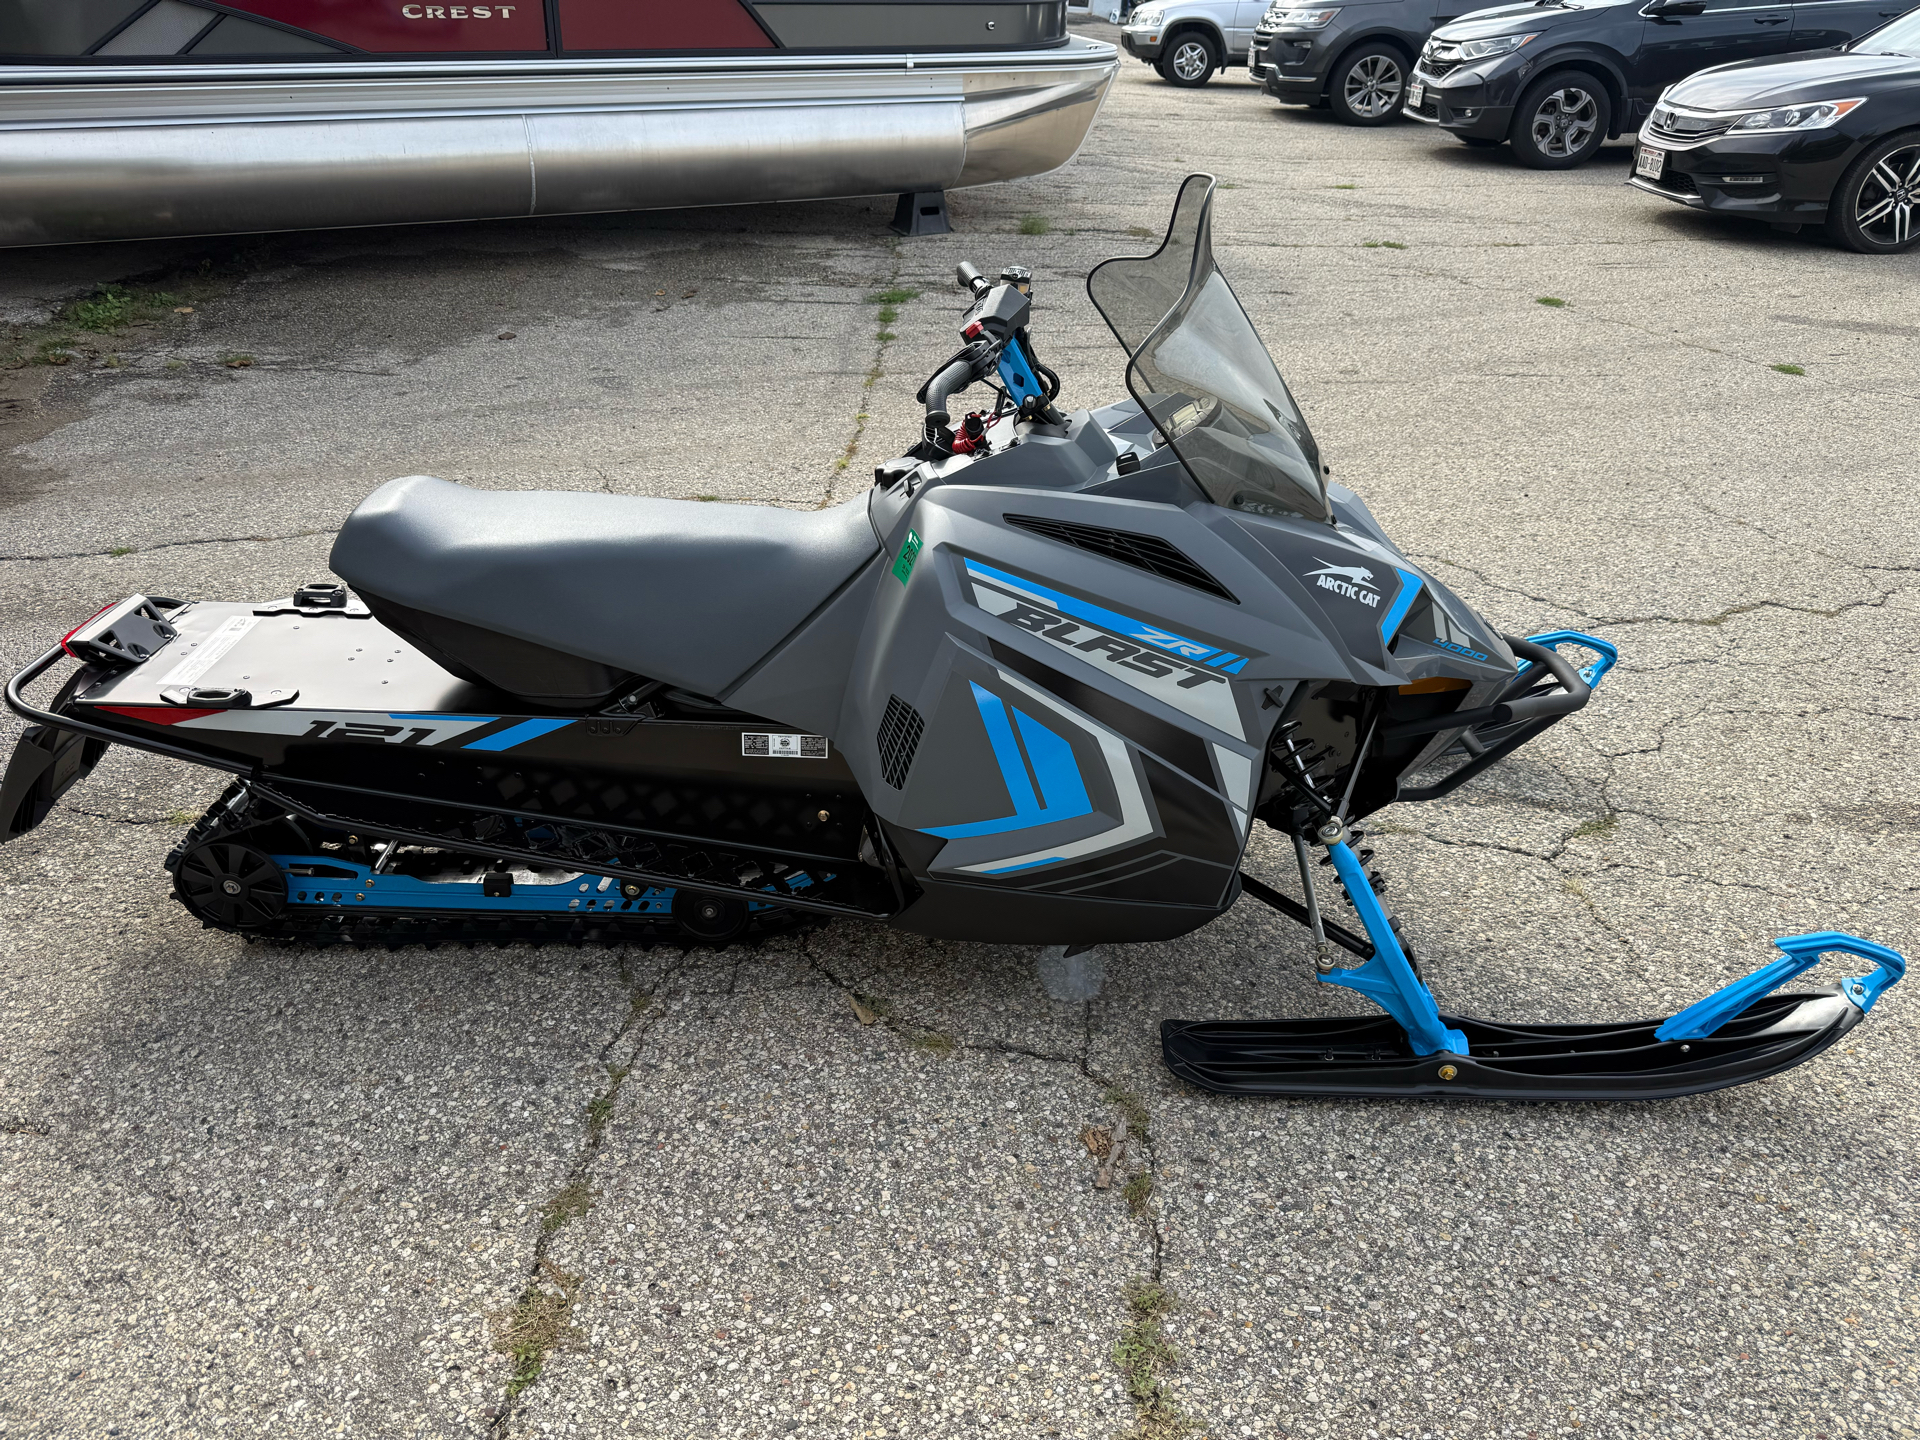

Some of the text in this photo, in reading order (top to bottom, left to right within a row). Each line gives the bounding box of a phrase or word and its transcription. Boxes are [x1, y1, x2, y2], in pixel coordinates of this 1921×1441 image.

[402, 4, 516, 19] CREST
[1316, 574, 1381, 608] ARCTIC CAT
[996, 602, 1226, 689] BLAST
[1130, 625, 1210, 657] ZR
[1432, 638, 1488, 661] 4000
[301, 720, 437, 746] 121
